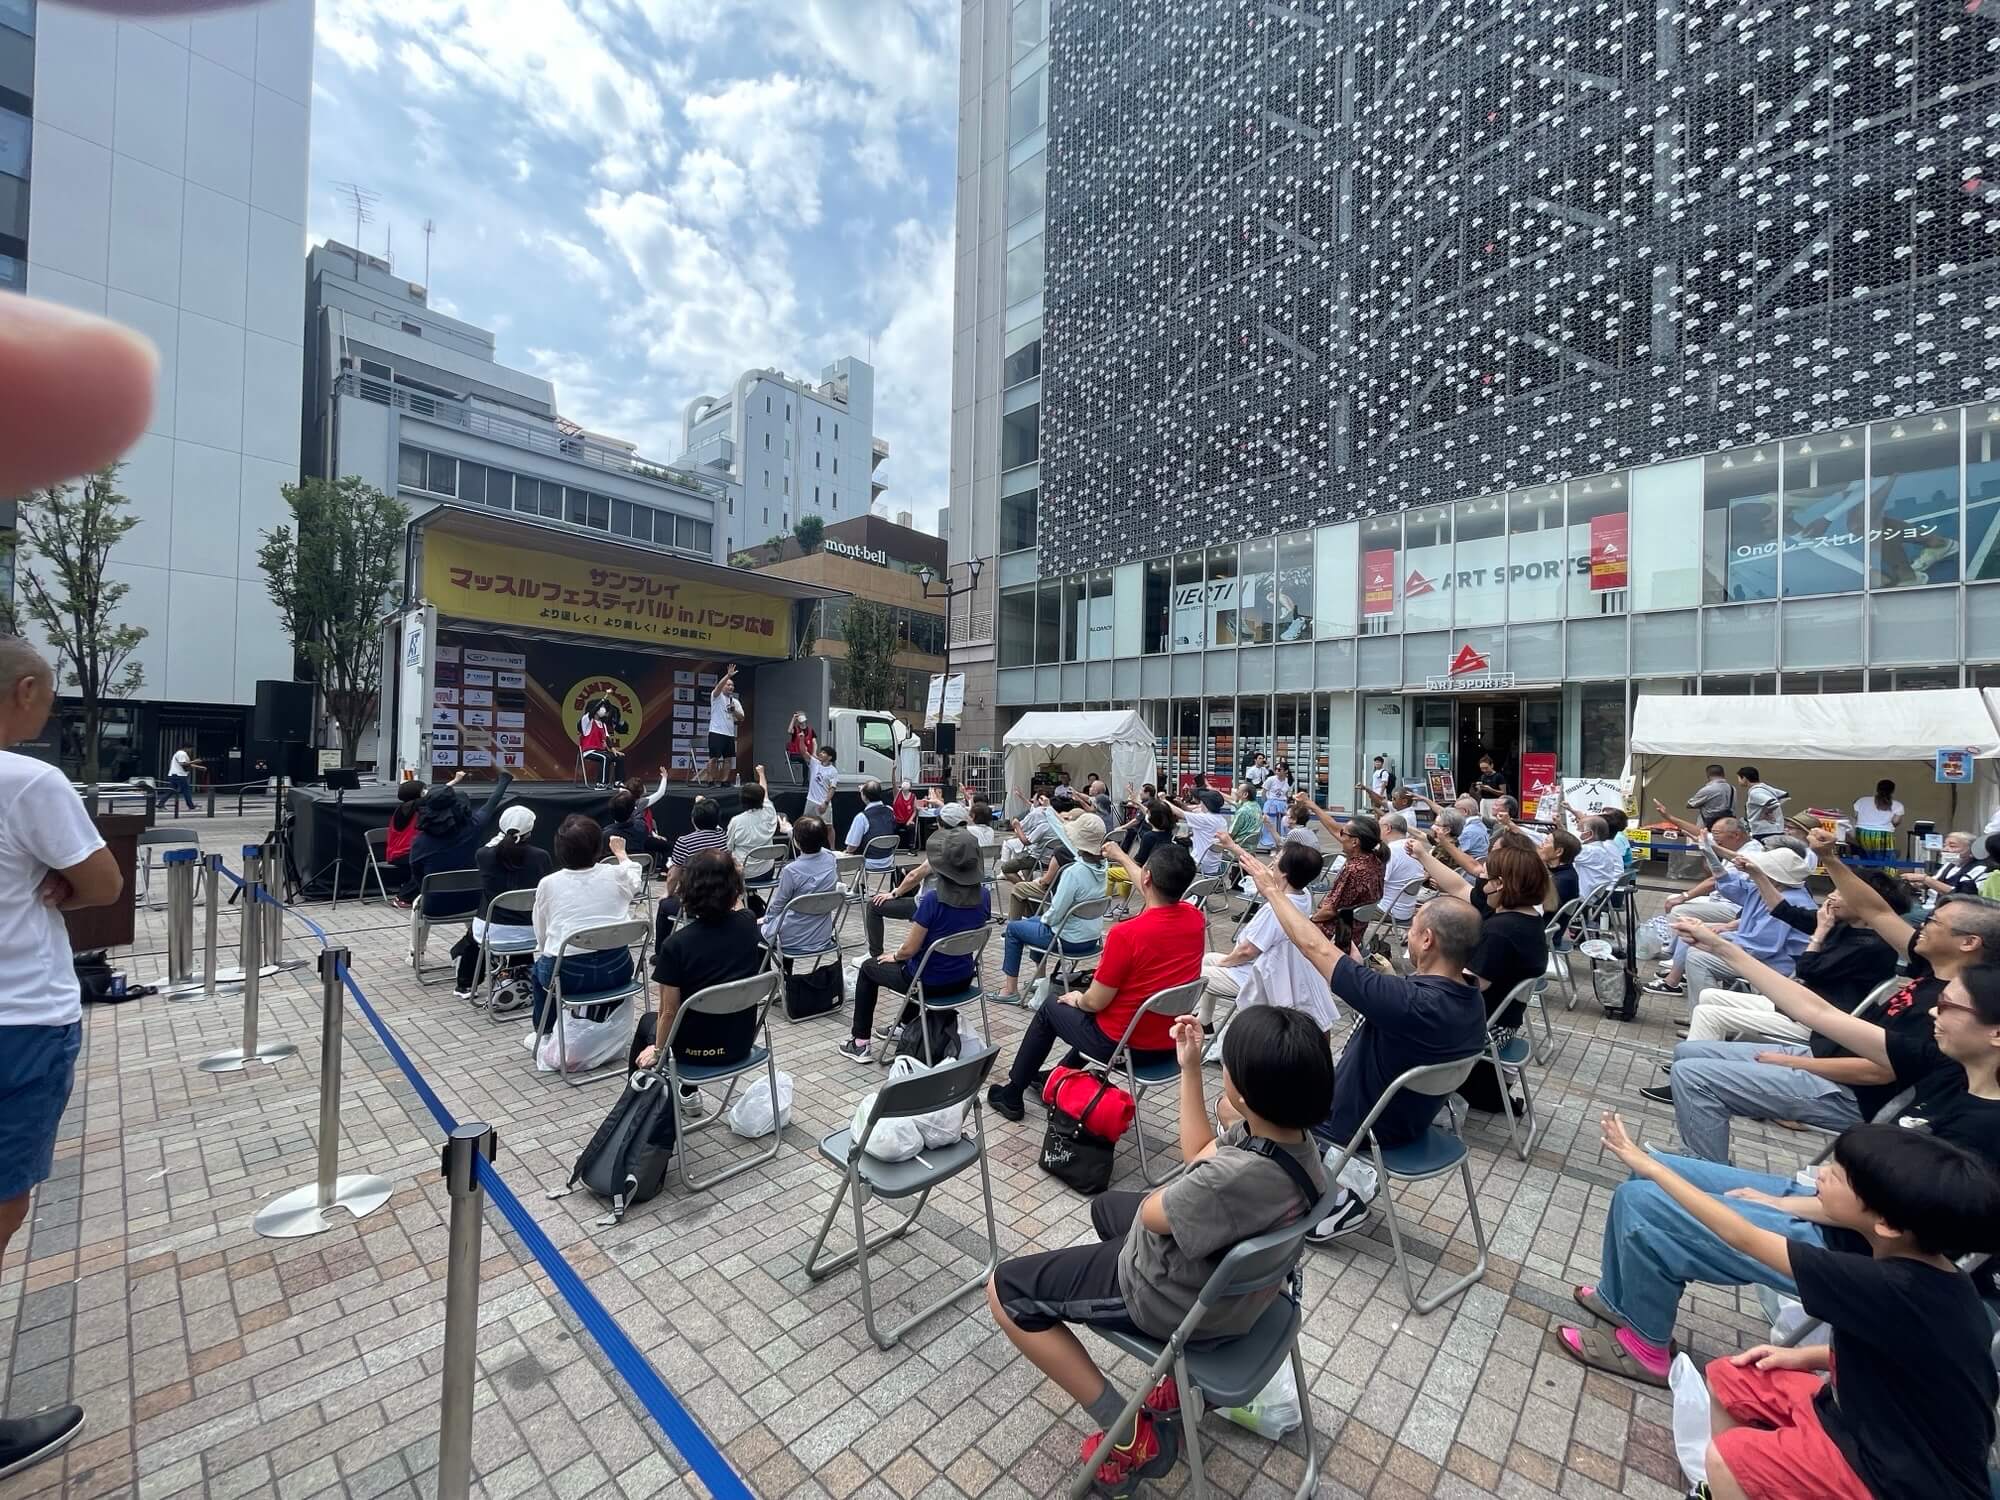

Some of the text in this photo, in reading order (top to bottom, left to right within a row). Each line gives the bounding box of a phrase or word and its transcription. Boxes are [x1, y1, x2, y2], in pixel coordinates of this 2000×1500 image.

[1737, 524, 1938, 557] Onのレースセレクション
[590, 568, 680, 600] サンプレイ
[1442, 555, 1592, 591] ART SPORTS
[678, 606, 694, 624] in
[1430, 678, 1509, 690] ART SPORTS
[703, 1049, 716, 1057] DO
